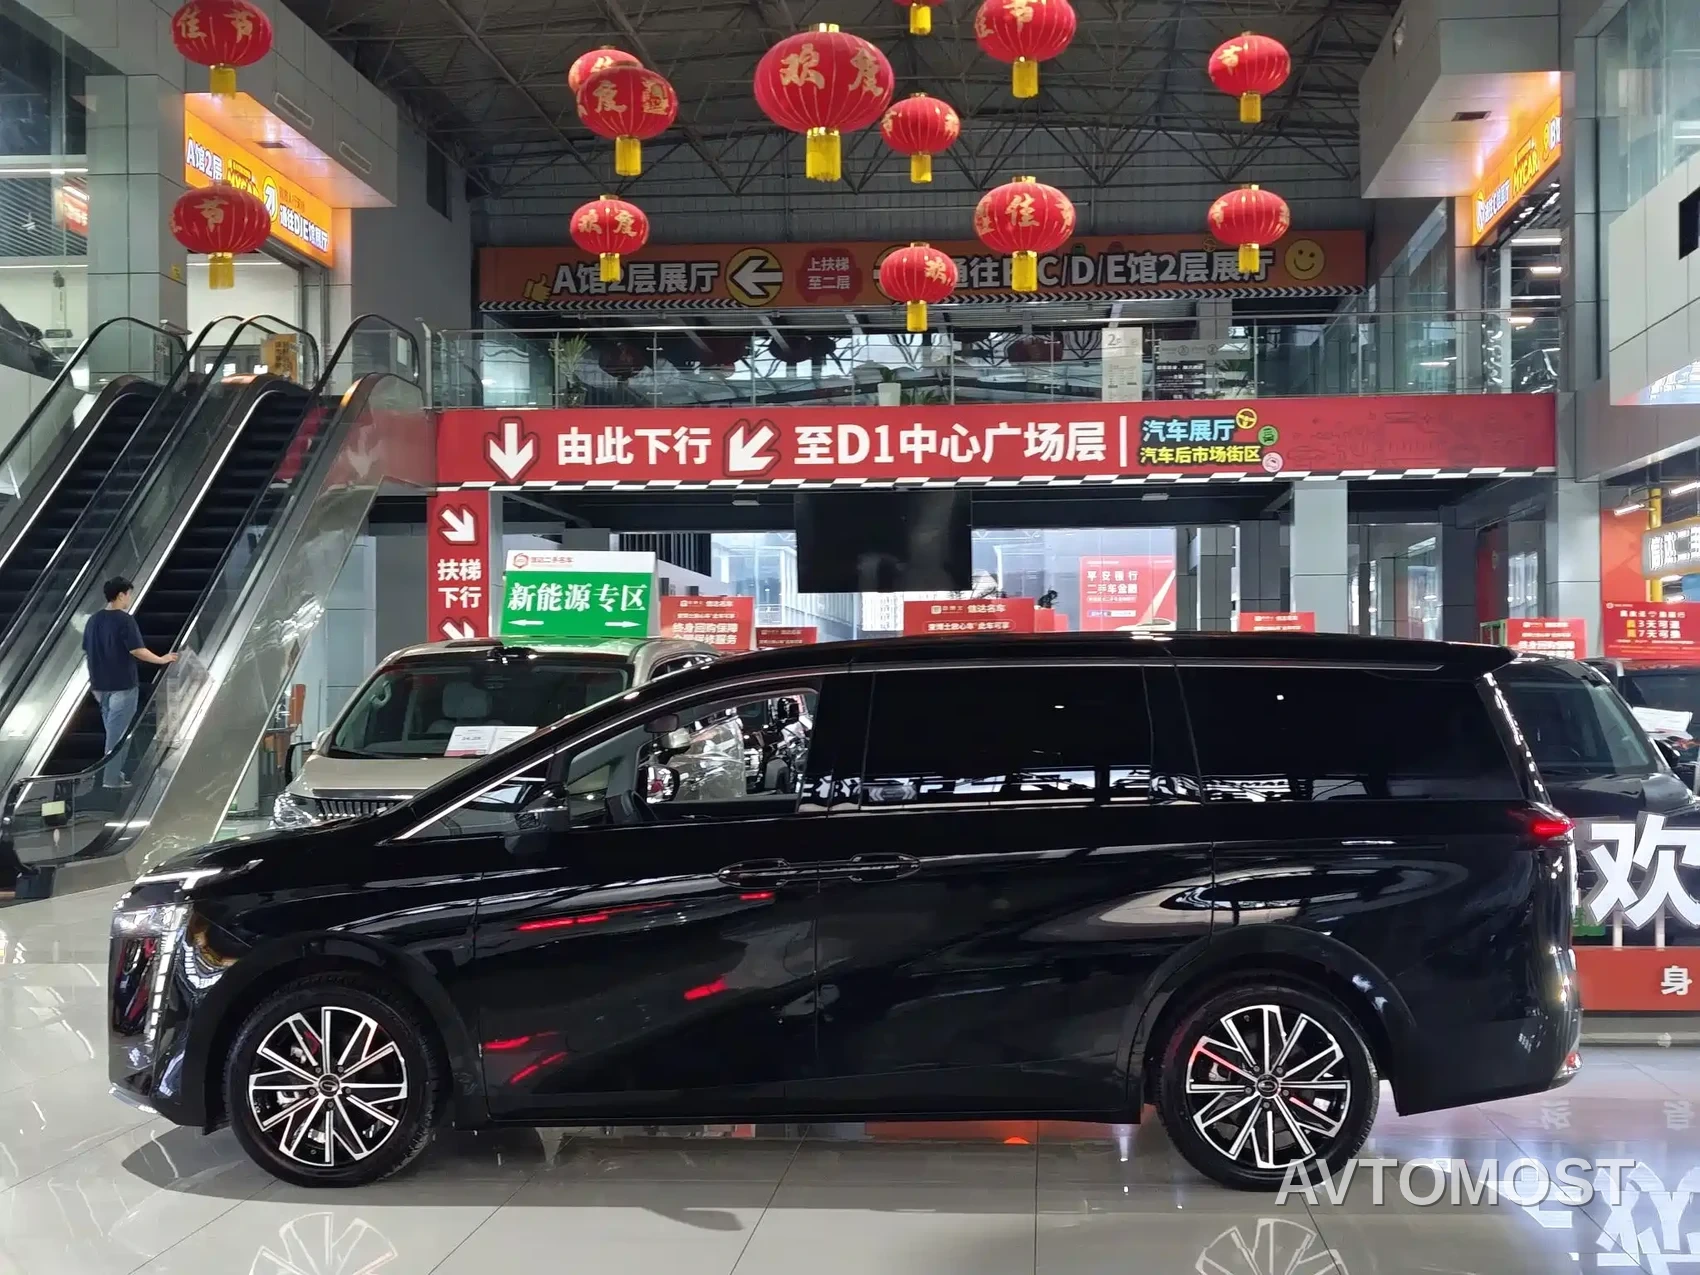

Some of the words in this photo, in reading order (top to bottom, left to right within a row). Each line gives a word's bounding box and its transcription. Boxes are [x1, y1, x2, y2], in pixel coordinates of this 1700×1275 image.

[807, 256, 850, 272] 上扶梯
[808, 275, 851, 290] 至二层
[794, 421, 1107, 465] 至D1中心广场层
[1142, 418, 1236, 443] 汽车展厅
[557, 426, 712, 466] 由此下行
[1139, 444, 1263, 464] 汽车后市场街区
[437, 558, 483, 582] 扶梯
[437, 586, 483, 609] 下行
[507, 582, 648, 613] 新能源专区
[1589, 812, 1700, 929] 欢
[1660, 964, 1693, 996] 身
